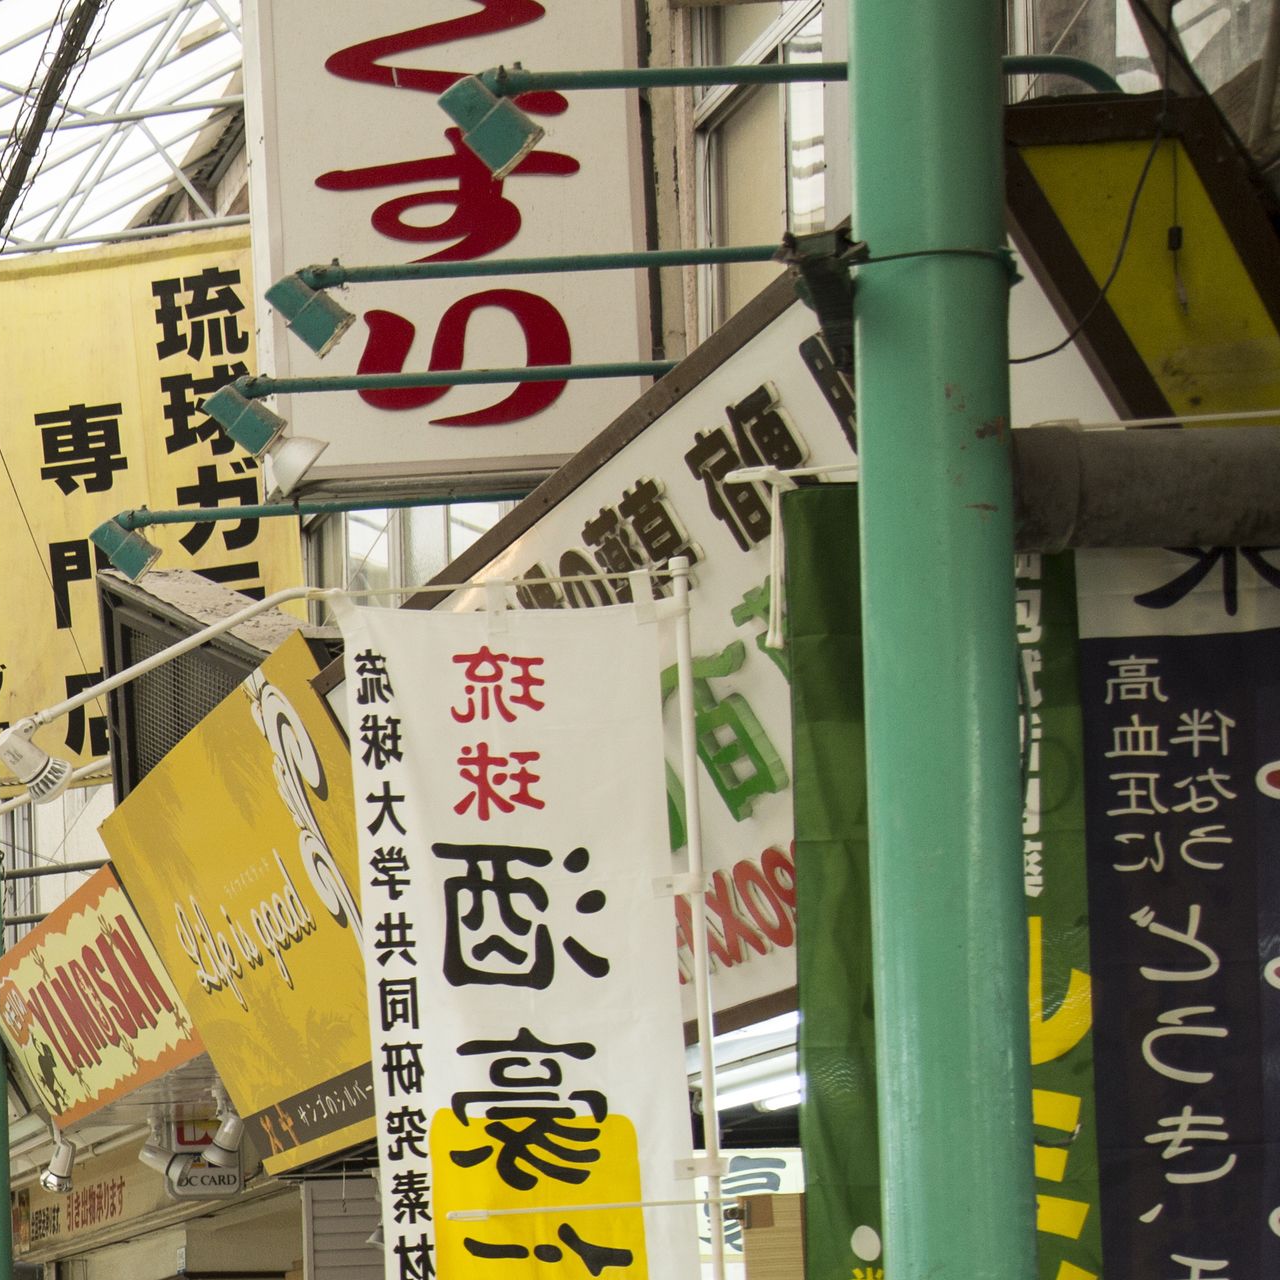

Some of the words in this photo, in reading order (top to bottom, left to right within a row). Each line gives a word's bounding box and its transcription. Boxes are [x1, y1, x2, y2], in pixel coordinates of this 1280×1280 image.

[174, 895, 249, 1013] Life
[220, 904, 264, 971] is
[250, 848, 317, 991] good
[201, 1174, 238, 1187] CARD
